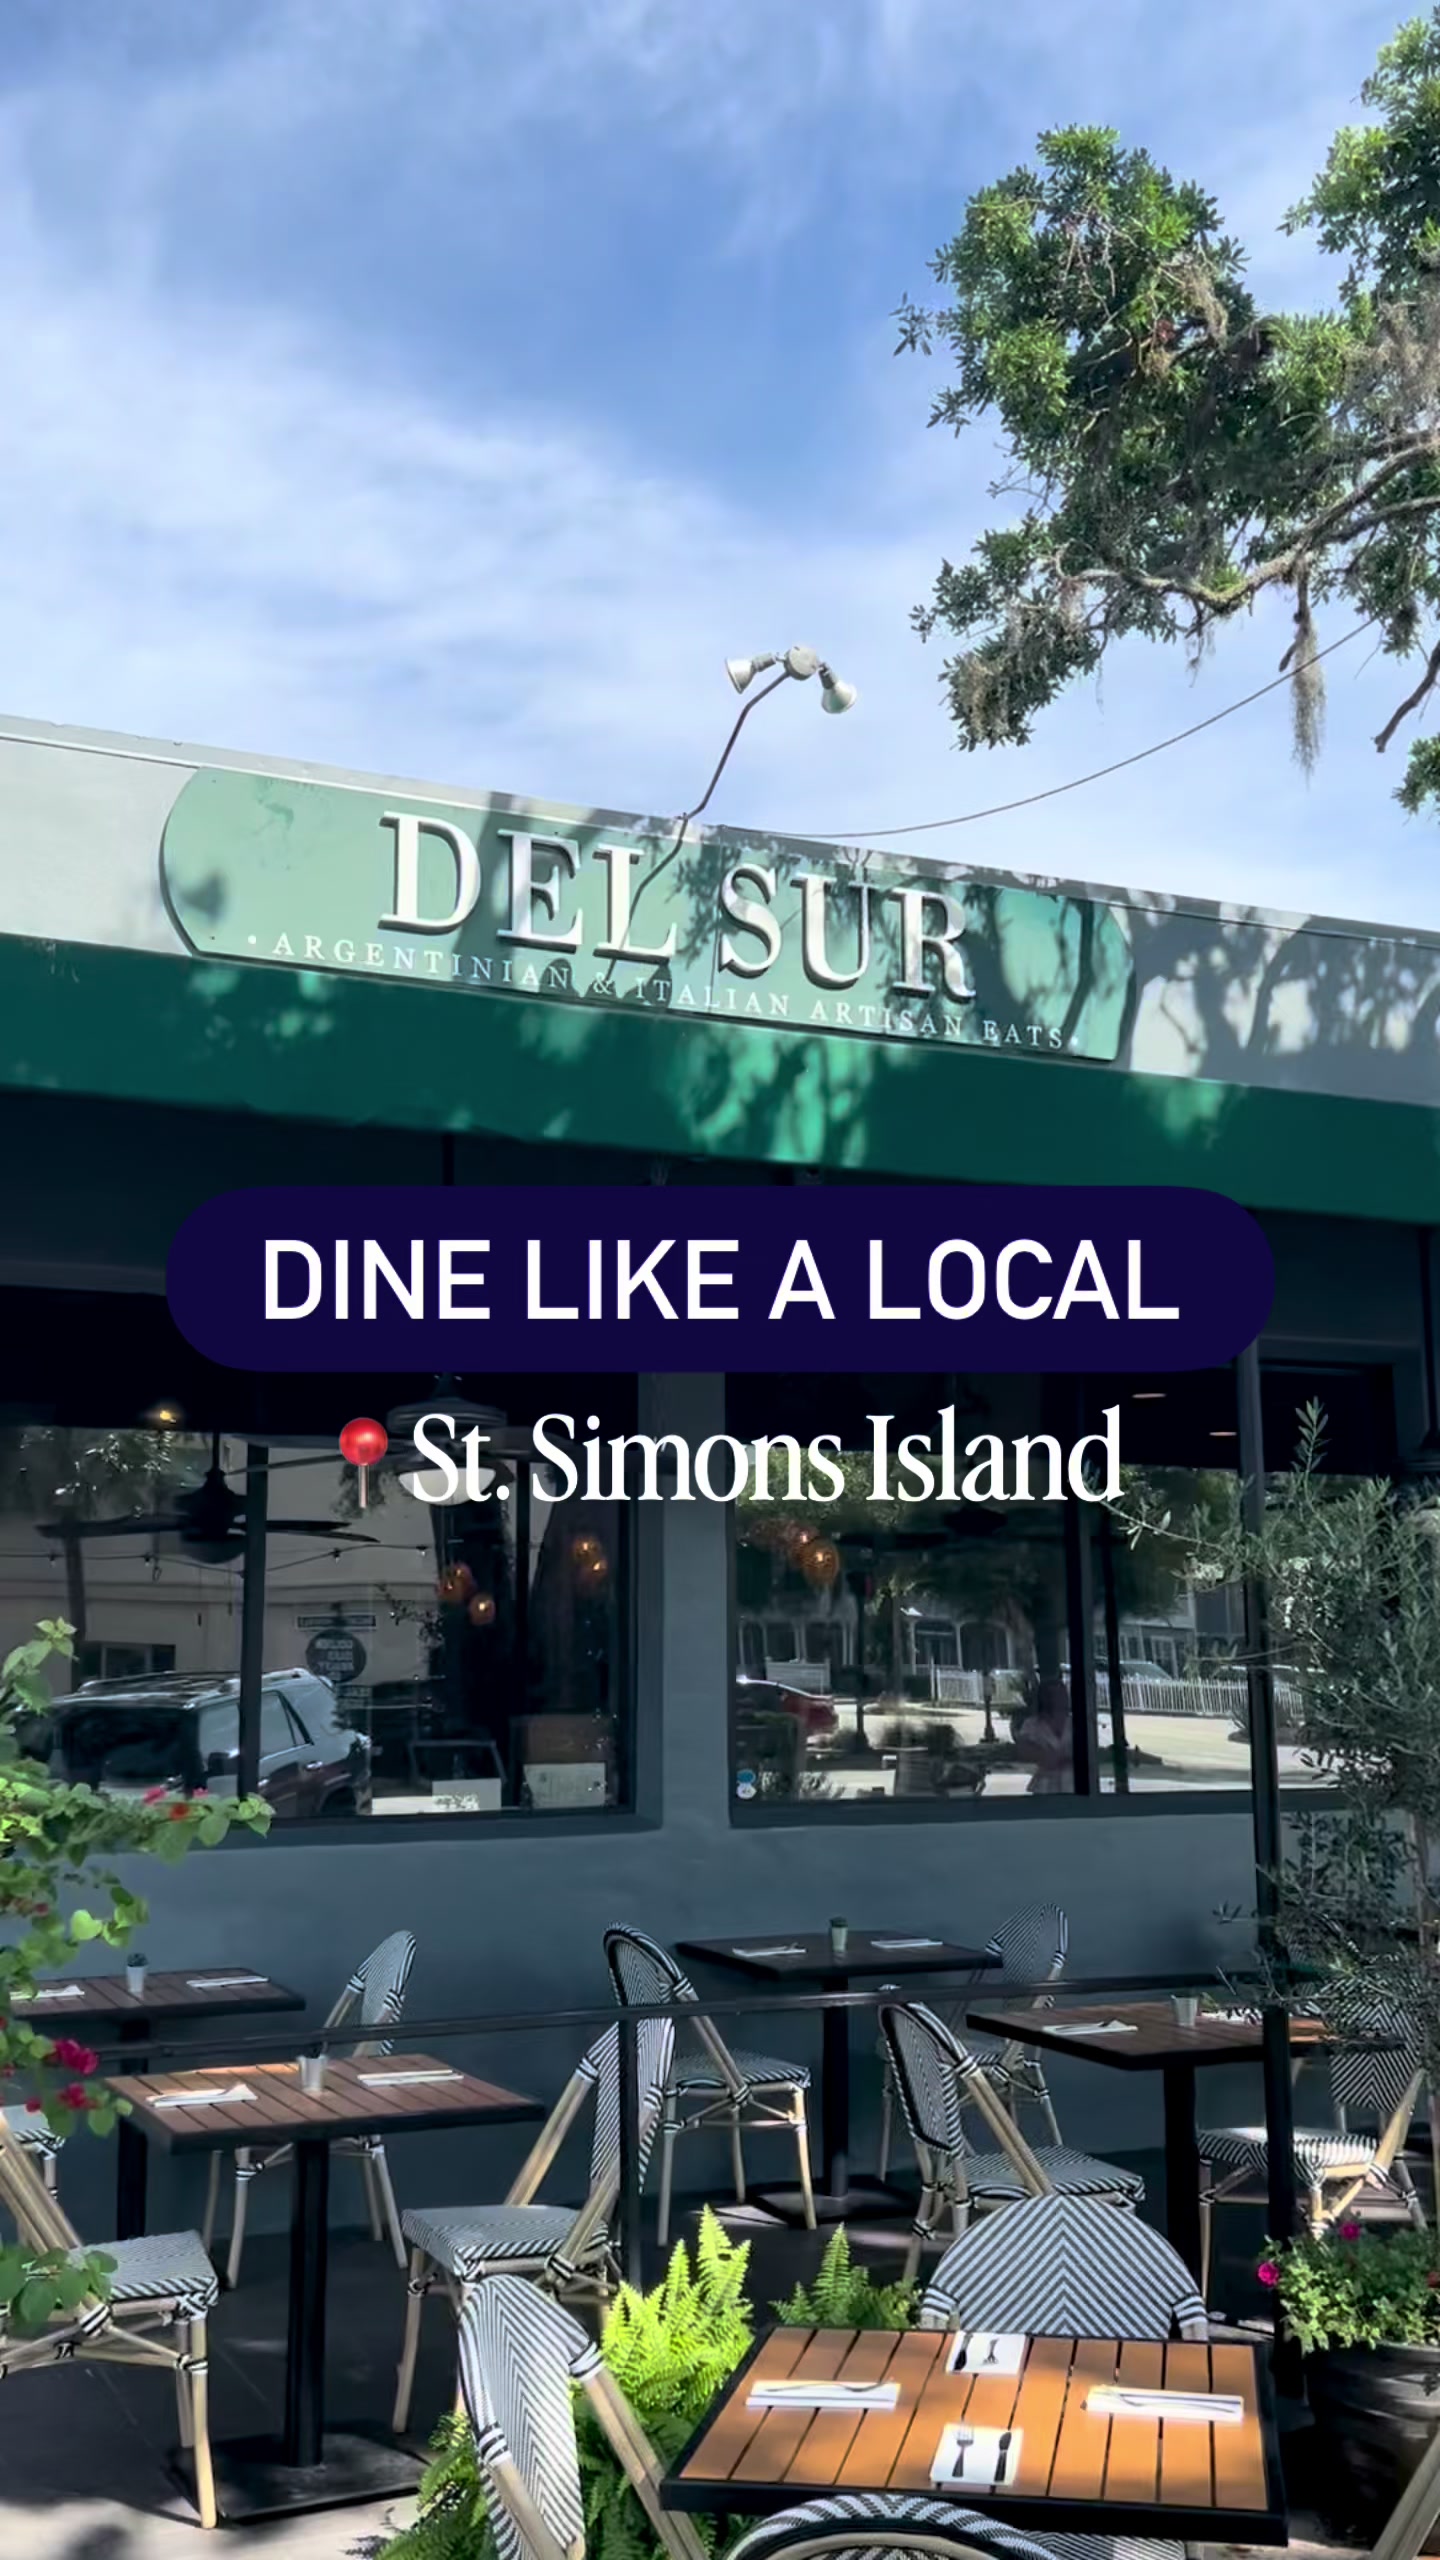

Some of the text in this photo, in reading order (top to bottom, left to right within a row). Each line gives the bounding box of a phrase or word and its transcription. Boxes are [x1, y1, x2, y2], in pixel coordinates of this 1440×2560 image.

[379, 811, 976, 1002] DEL SUR
[272, 932, 1063, 1049] ARGENTINIAN & ITALIAN ARTISAN EATS
